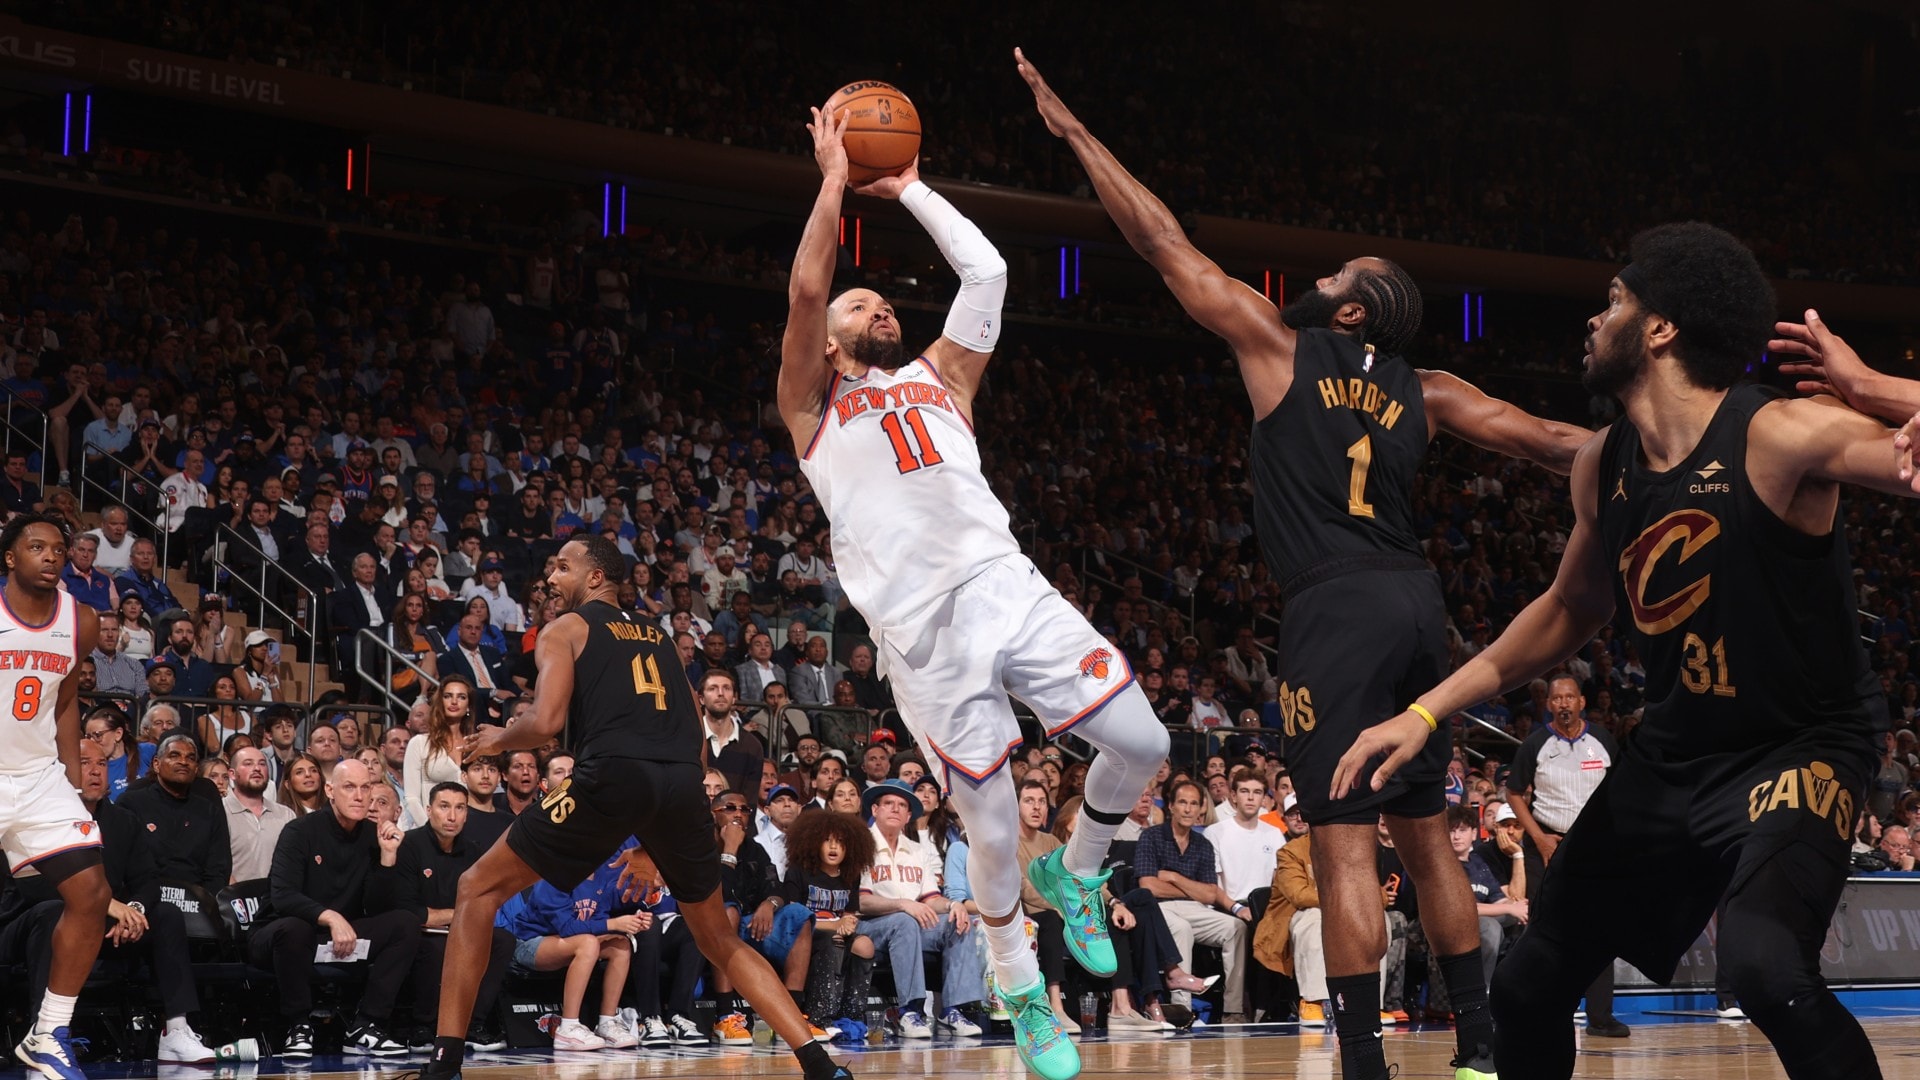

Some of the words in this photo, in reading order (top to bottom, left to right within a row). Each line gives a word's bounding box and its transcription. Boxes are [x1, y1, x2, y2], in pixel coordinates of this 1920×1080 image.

[126, 58, 201, 91] SUITE
[210, 72, 285, 106] LEVEL
[835, 386, 886, 427] NEW
[886, 382, 953, 414] YORK
[1318, 377, 1404, 430] HARDEN
[880, 406, 944, 475] 11
[1347, 432, 1375, 519] 1
[1689, 483, 1730, 494] CLIFFS
[1619, 508, 1721, 636] C
[605, 621, 664, 646] MOBLEY
[30, 650, 72, 676] YORK
[631, 652, 667, 711] 4
[1680, 632, 1736, 697] 31
[12, 676, 43, 721] 8
[1748, 761, 1853, 841] CAVS
[896, 864, 923, 885] YOR
[1862, 909, 1901, 951] UP
